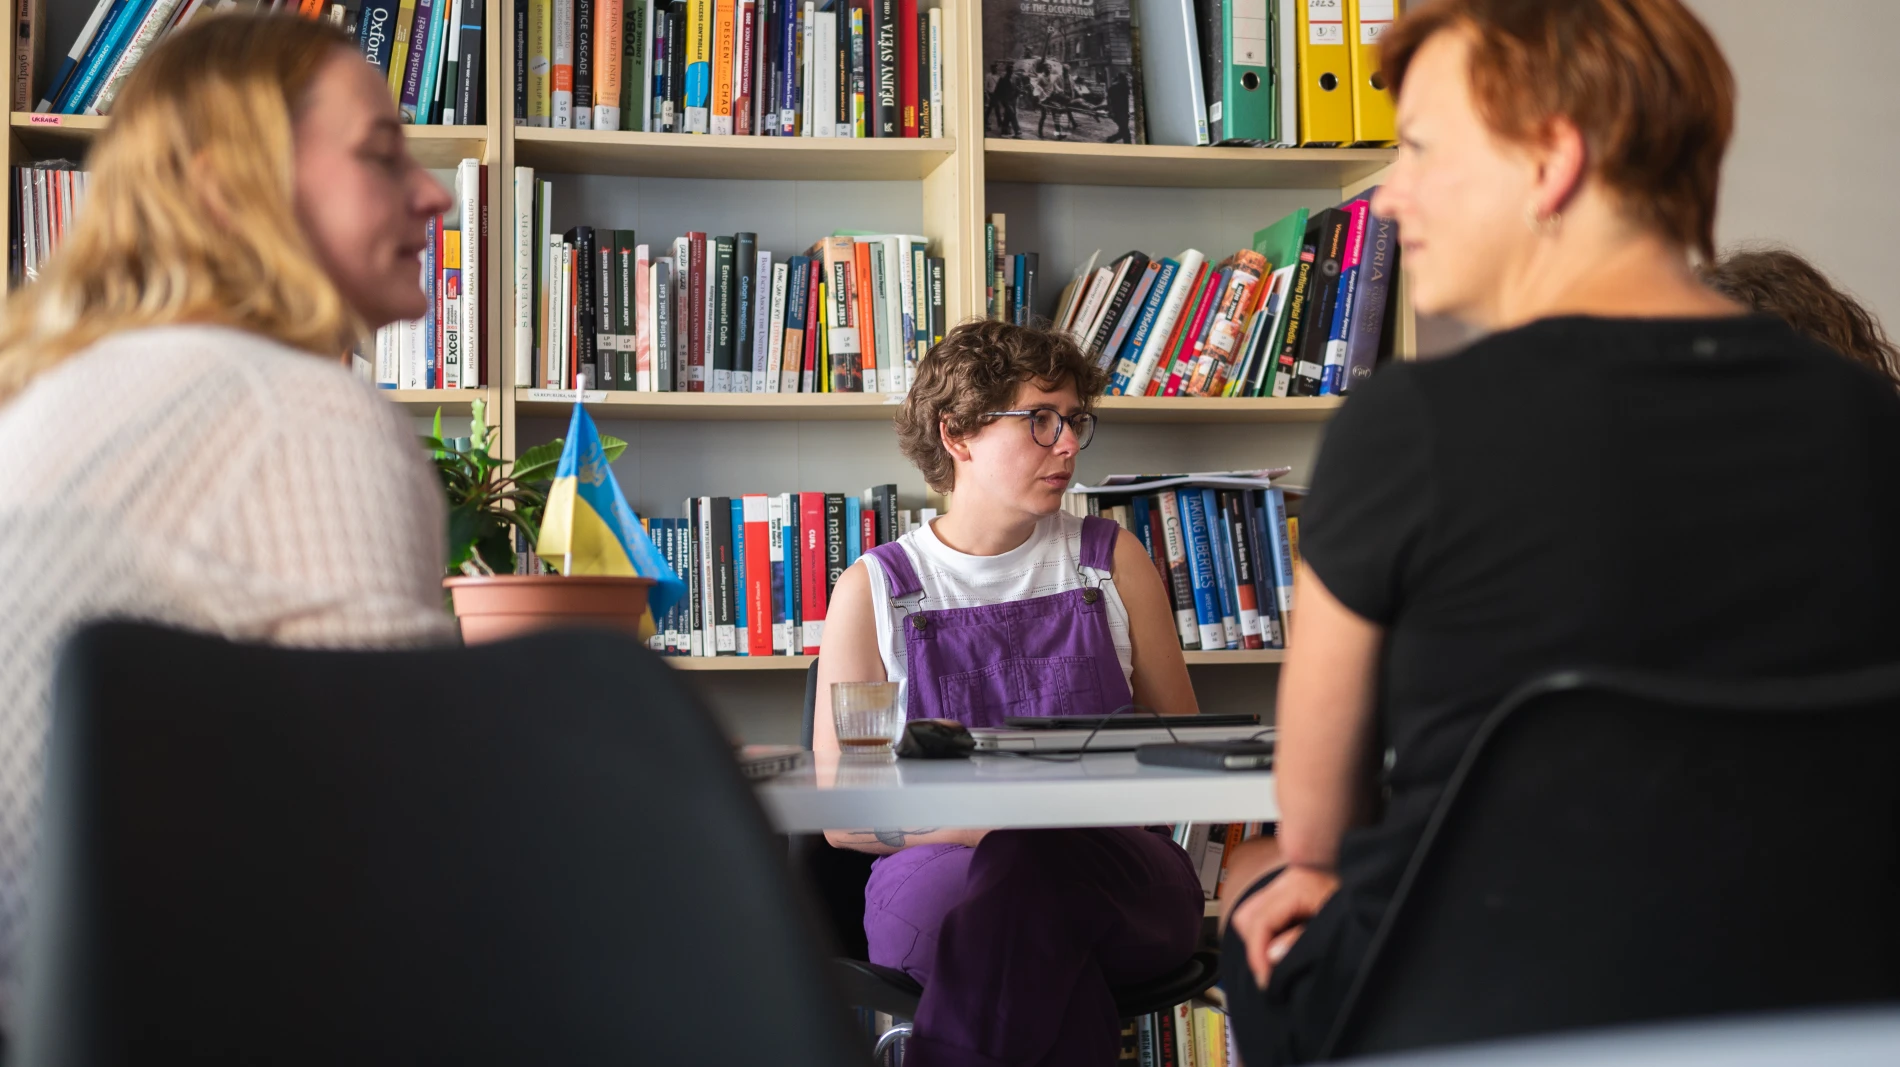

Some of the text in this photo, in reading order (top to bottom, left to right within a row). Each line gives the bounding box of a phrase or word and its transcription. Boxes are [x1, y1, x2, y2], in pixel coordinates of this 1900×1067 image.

[362, 7, 372, 34] Advanced
[1032, 4, 1047, 12] THE
[1048, 5, 1094, 16] OCCUPATION
[366, 8, 388, 65] Oxford
[413, 16, 426, 50] pobřeží
[580, 32, 588, 75] CASCADE
[625, 10, 636, 56] DOBA
[877, 24, 893, 61] SVĚTA
[17, 54, 29, 110] Маша Трауб
[70, 44, 111, 107] RECLAIMING DEMOCRACY
[406, 53, 421, 96] Jadranské
[879, 64, 894, 106] DĚJINY
[1330, 223, 1343, 258] Viewpoints
[1370, 215, 1392, 282] EMORIA
[519, 212, 528, 328] SEVERNÍ ČECHY
[799, 264, 807, 288] NOWHERE
[720, 265, 730, 324] Entrepreneurial
[835, 264, 846, 325] STŘET CIVILIZACÍ
[1112, 280, 1131, 309] GREAT
[1132, 264, 1175, 346] EVROPSKÁ REFERENDA
[1285, 262, 1310, 344] Crafting Digital Media
[740, 301, 748, 341] Revelations
[1340, 317, 1349, 338] Základy
[446, 331, 457, 364] Excel
[829, 519, 841, 562] nation
[1163, 492, 1179, 556] War Crimes
[1189, 494, 1215, 588] TAKING LIBERTIES
[1142, 1030, 1150, 1050] NORTH
